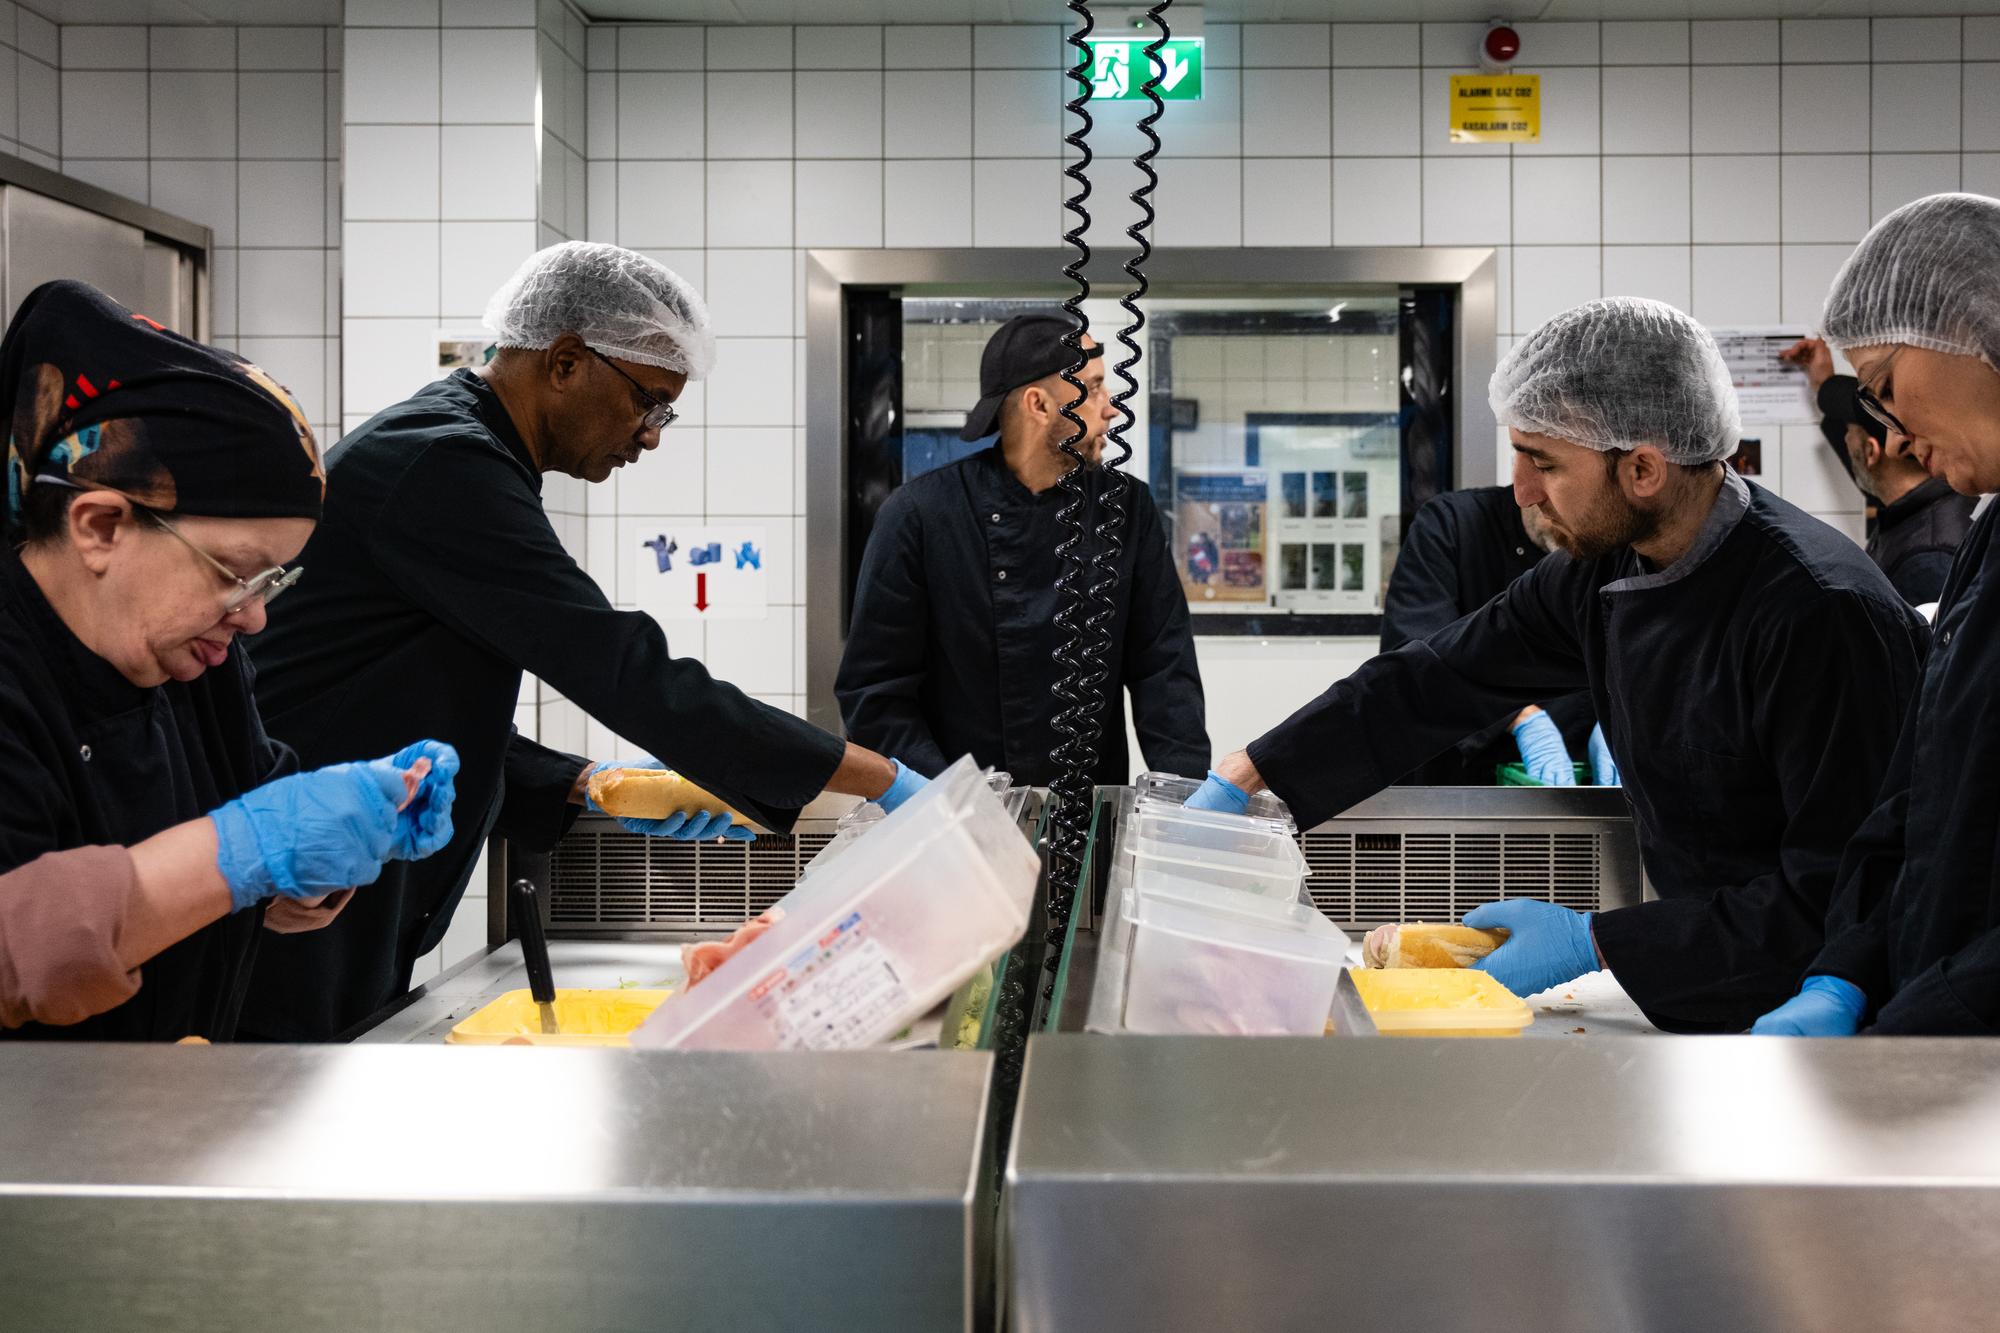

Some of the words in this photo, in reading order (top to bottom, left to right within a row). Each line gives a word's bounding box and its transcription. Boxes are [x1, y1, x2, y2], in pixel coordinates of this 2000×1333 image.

[1459, 88, 1492, 97] ALARME
[1496, 88, 1512, 97] GAZ
[1515, 88, 1532, 97] CO2
